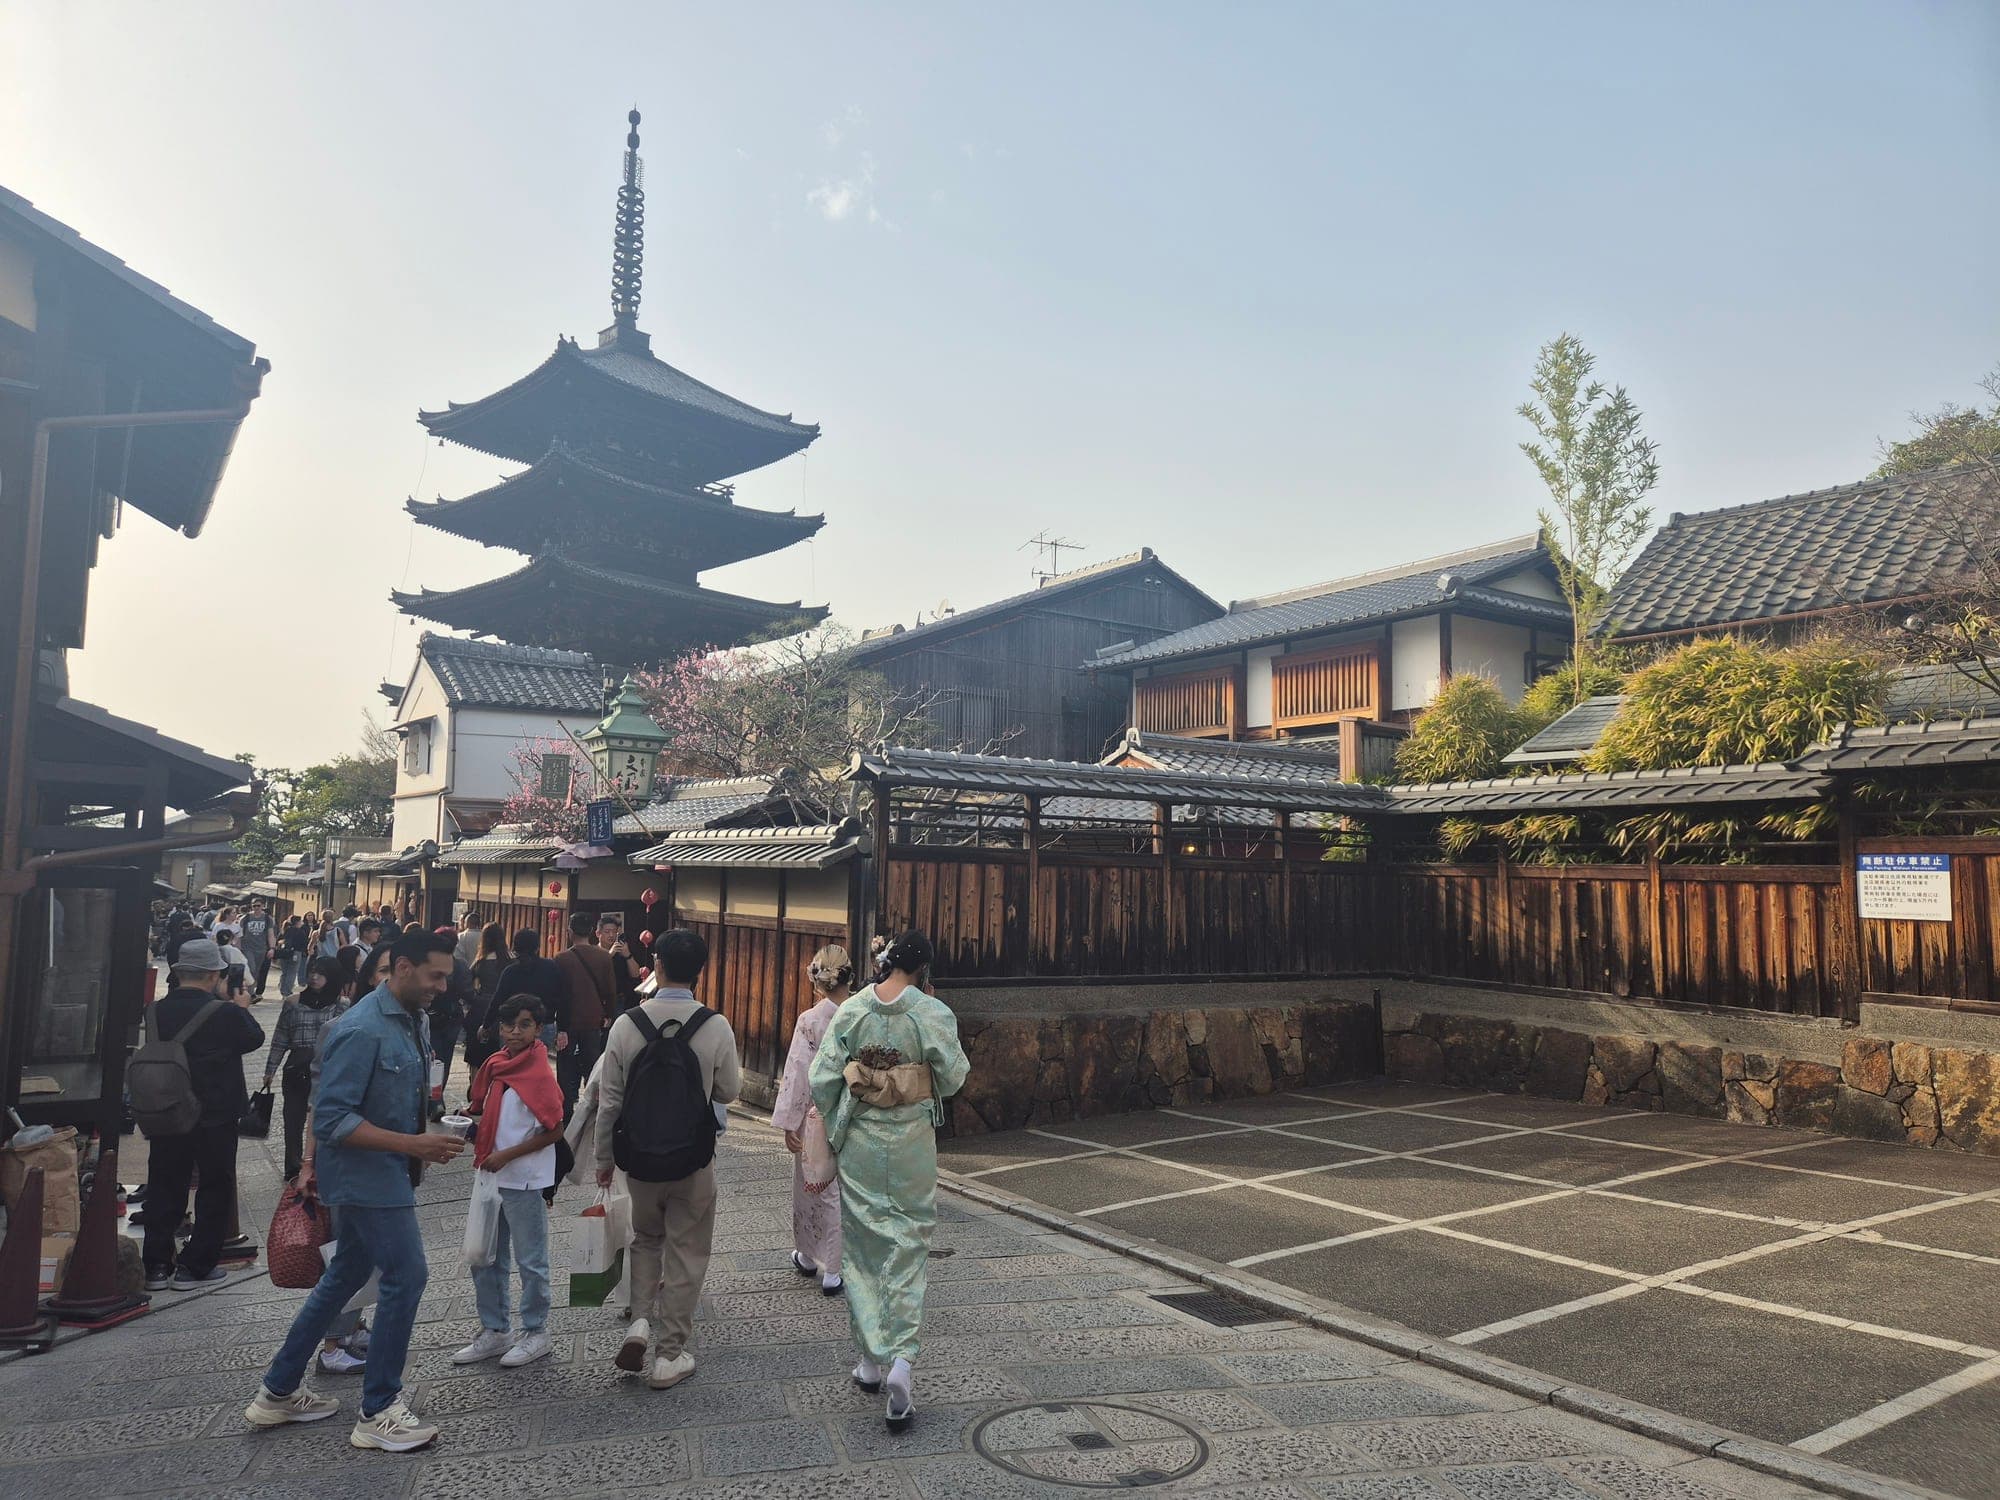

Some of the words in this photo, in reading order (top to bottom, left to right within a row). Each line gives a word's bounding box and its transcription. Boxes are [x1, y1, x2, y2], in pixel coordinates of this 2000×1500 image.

[1862, 856, 1943, 866] 無断駐停車禁止
